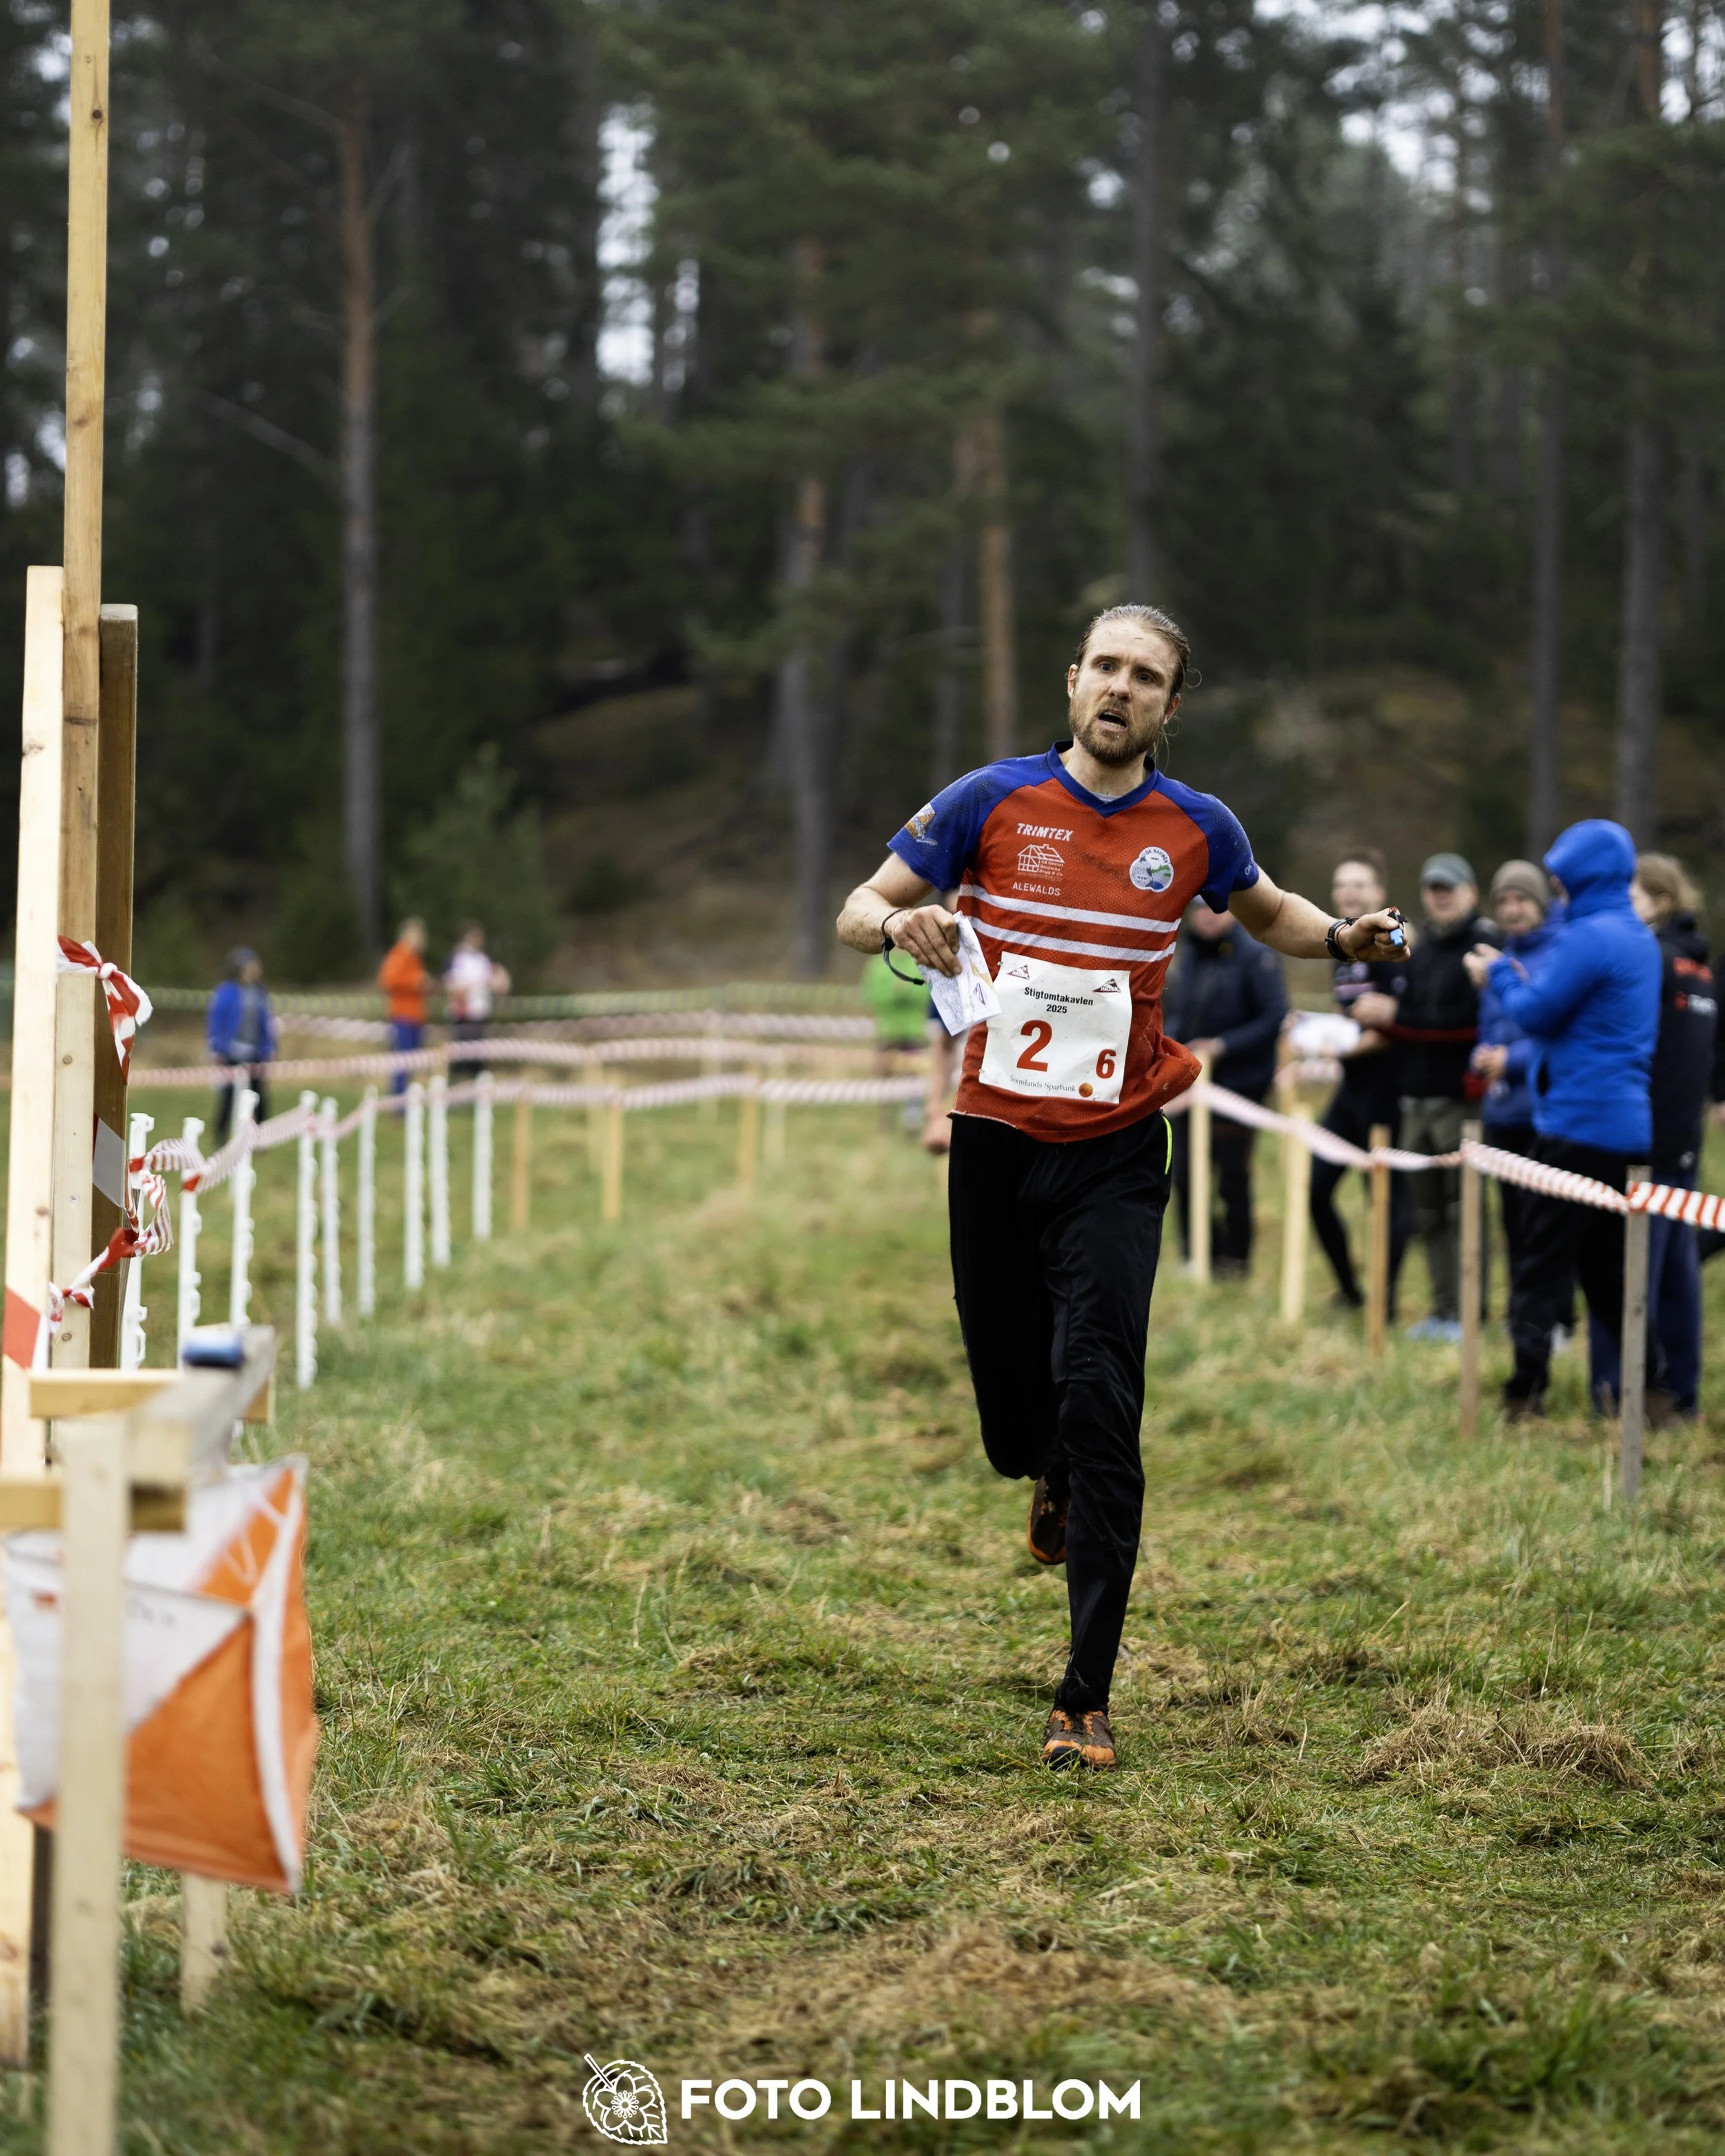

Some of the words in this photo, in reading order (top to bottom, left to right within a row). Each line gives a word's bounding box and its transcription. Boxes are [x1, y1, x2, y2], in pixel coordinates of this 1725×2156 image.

[1016, 822, 1074, 842] TRIMTEX
[1012, 881, 1061, 896] ALEWALDS
[1024, 987, 1094, 1006] Stigtomtakavlen
[1046, 1004, 1067, 1014] 2025
[1016, 1019, 1053, 1072] 2
[1096, 1049, 1116, 1079] 6
[1044, 1082, 1076, 1092] Sparbank
